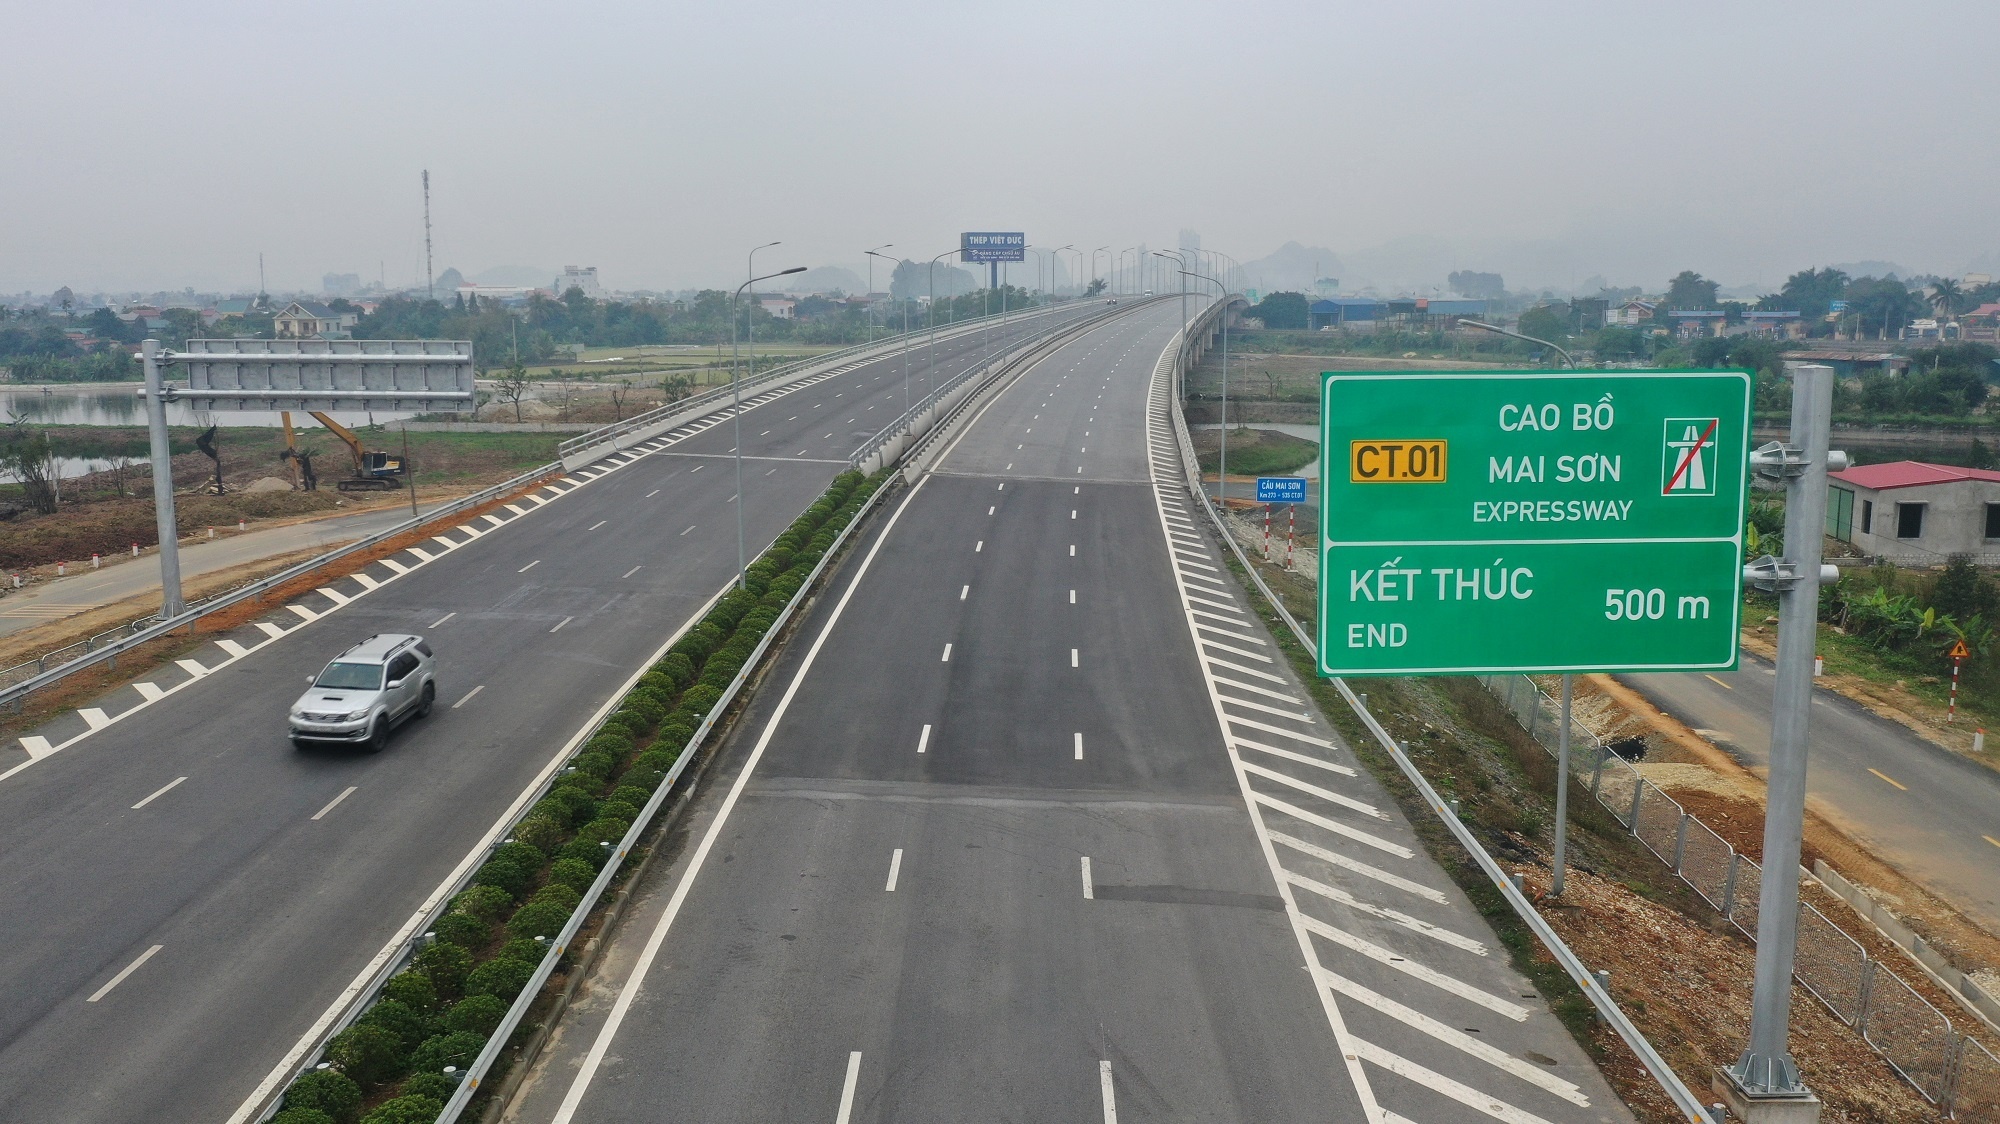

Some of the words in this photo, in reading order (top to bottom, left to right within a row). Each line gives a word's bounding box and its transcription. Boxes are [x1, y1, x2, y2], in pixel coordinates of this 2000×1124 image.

[1499, 404, 1561, 432] CAO
[1572, 392, 1614, 431] BỒ
[1356, 444, 1441, 479] CT.01
[1488, 456, 1545, 483] MAI
[1555, 452, 1621, 482] SƠN
[1275, 482, 1286, 490] MAI
[1288, 482, 1301, 490] SƠN
[1473, 500, 1633, 523] EXPRESSWAY
[1350, 557, 1421, 602] KẾT
[1431, 558, 1534, 601] THÚC
[1604, 588, 1667, 621] 500
[1677, 595, 1710, 620] m
[1348, 623, 1408, 648] END
